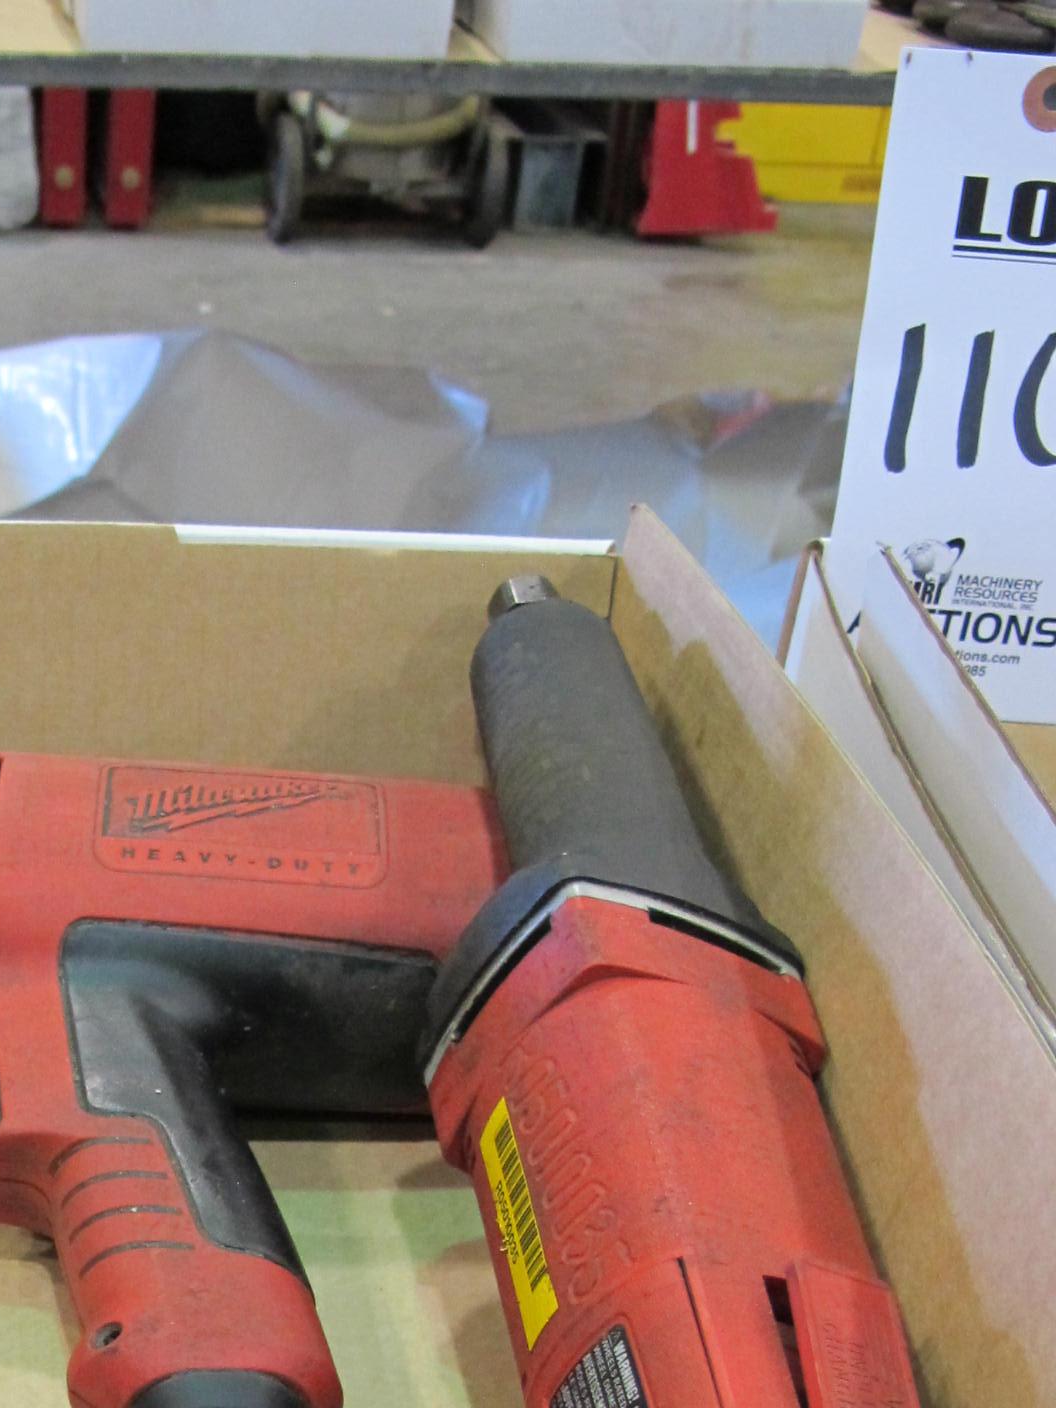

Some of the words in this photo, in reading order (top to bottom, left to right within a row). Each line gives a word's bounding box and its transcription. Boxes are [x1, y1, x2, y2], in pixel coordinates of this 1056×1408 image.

[957, 574, 1043, 591] MACHINERY
[954, 587, 1039, 603] RESOURCES
[121, 847, 361, 876] HEAVY-DUTY
[612, 1339, 640, 1404] WARNING!
